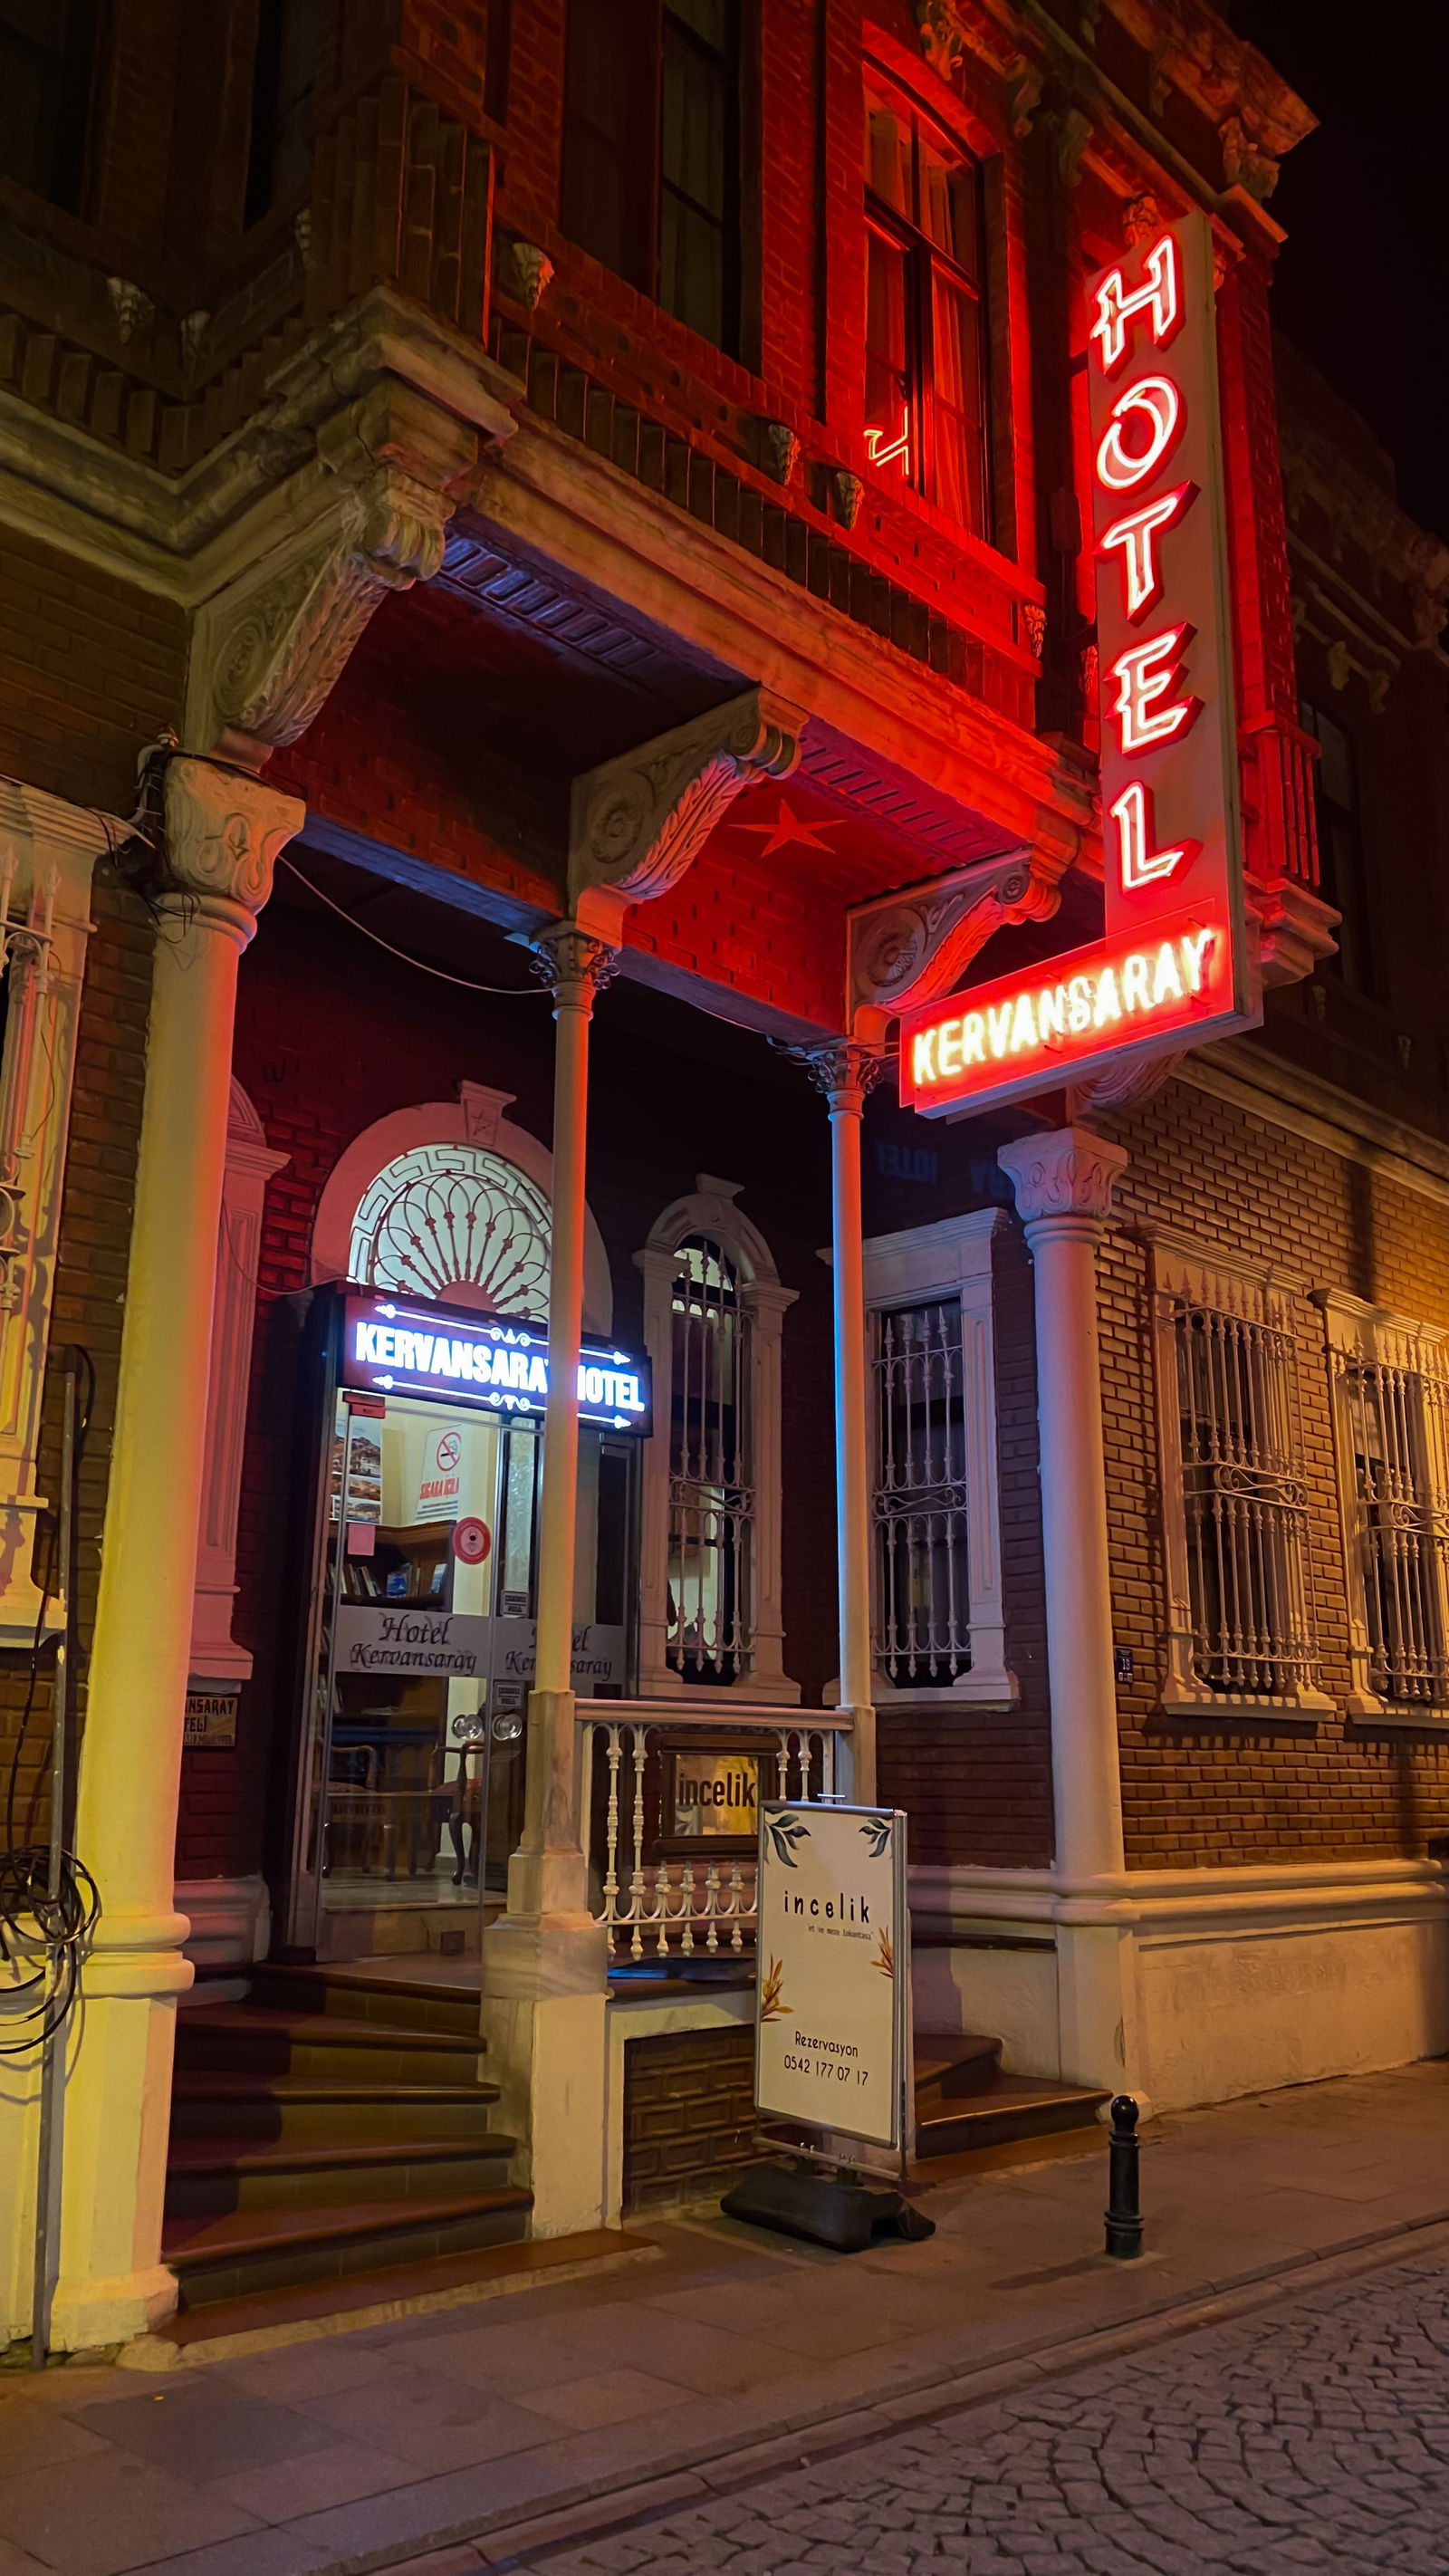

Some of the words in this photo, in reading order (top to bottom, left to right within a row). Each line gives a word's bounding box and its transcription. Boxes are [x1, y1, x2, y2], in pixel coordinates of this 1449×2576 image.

[1089, 233, 1194, 893] HOTEL
[913, 928, 1216, 1085] KERVANSARAY
[356, 1322, 549, 1394] KERVANSARA
[379, 1615, 454, 1645] Hotel
[350, 1643, 478, 1677] Kervansaray
[503, 1651, 613, 1682] Kersaray
[185, 1698, 235, 1716] NSARAY
[678, 1772, 756, 1808] incelik
[784, 1889, 869, 1924] incelik
[794, 2030, 859, 2058] Rezervasyon
[783, 2054, 811, 2074] 0542
[816, 2061, 834, 2079] 177
[837, 2066, 851, 2082] 07
[857, 2071, 869, 2086] 17
